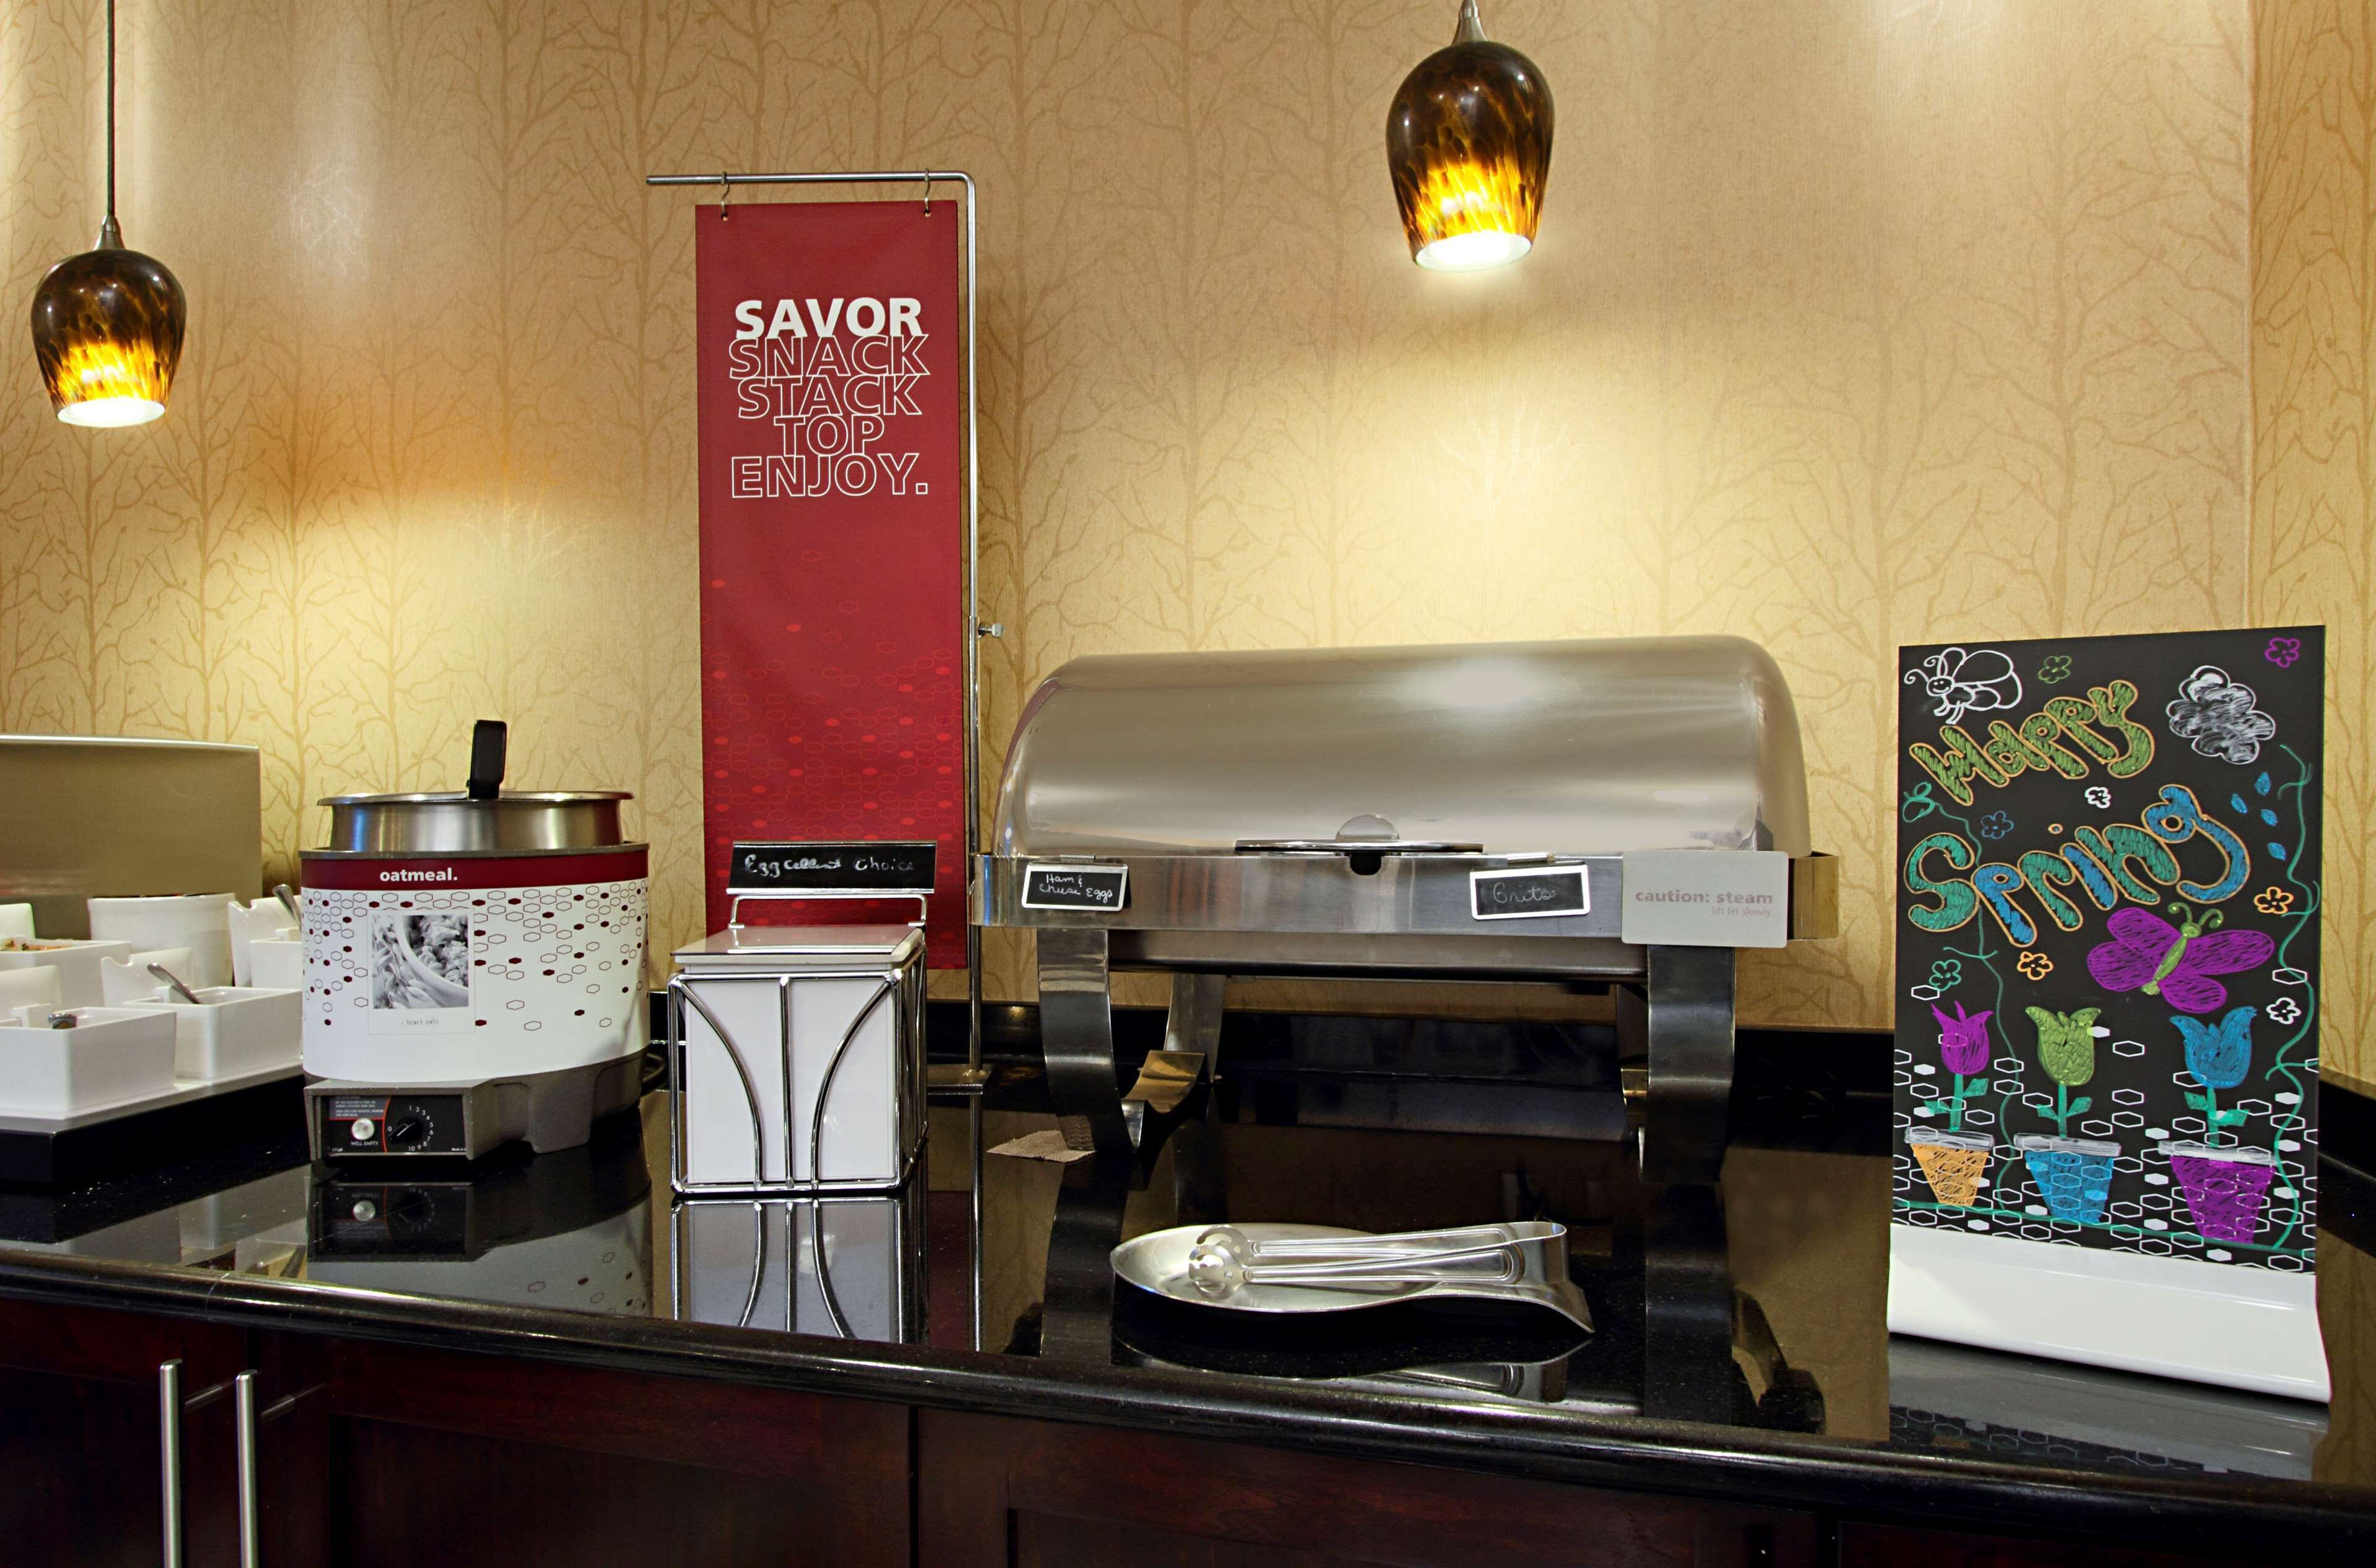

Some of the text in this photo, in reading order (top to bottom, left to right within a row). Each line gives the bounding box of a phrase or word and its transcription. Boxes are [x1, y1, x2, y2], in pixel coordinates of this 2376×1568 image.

[735, 297, 923, 340] SAVOR
[728, 334, 931, 379] SNACK
[737, 374, 922, 419] STACK
[774, 413, 885, 457] TOP
[732, 452, 928, 498] ENJOY.
[379, 866, 458, 882] oatmeal.
[1046, 873, 1074, 884] Ham
[1904, 783, 2251, 948] Spring
[1086, 887, 1113, 904] Eggs
[1493, 881, 1556, 904] Grits
[1635, 890, 1773, 904] caution: steam
[1711, 907, 1724, 915] lift
[1727, 907, 1739, 916] lid
